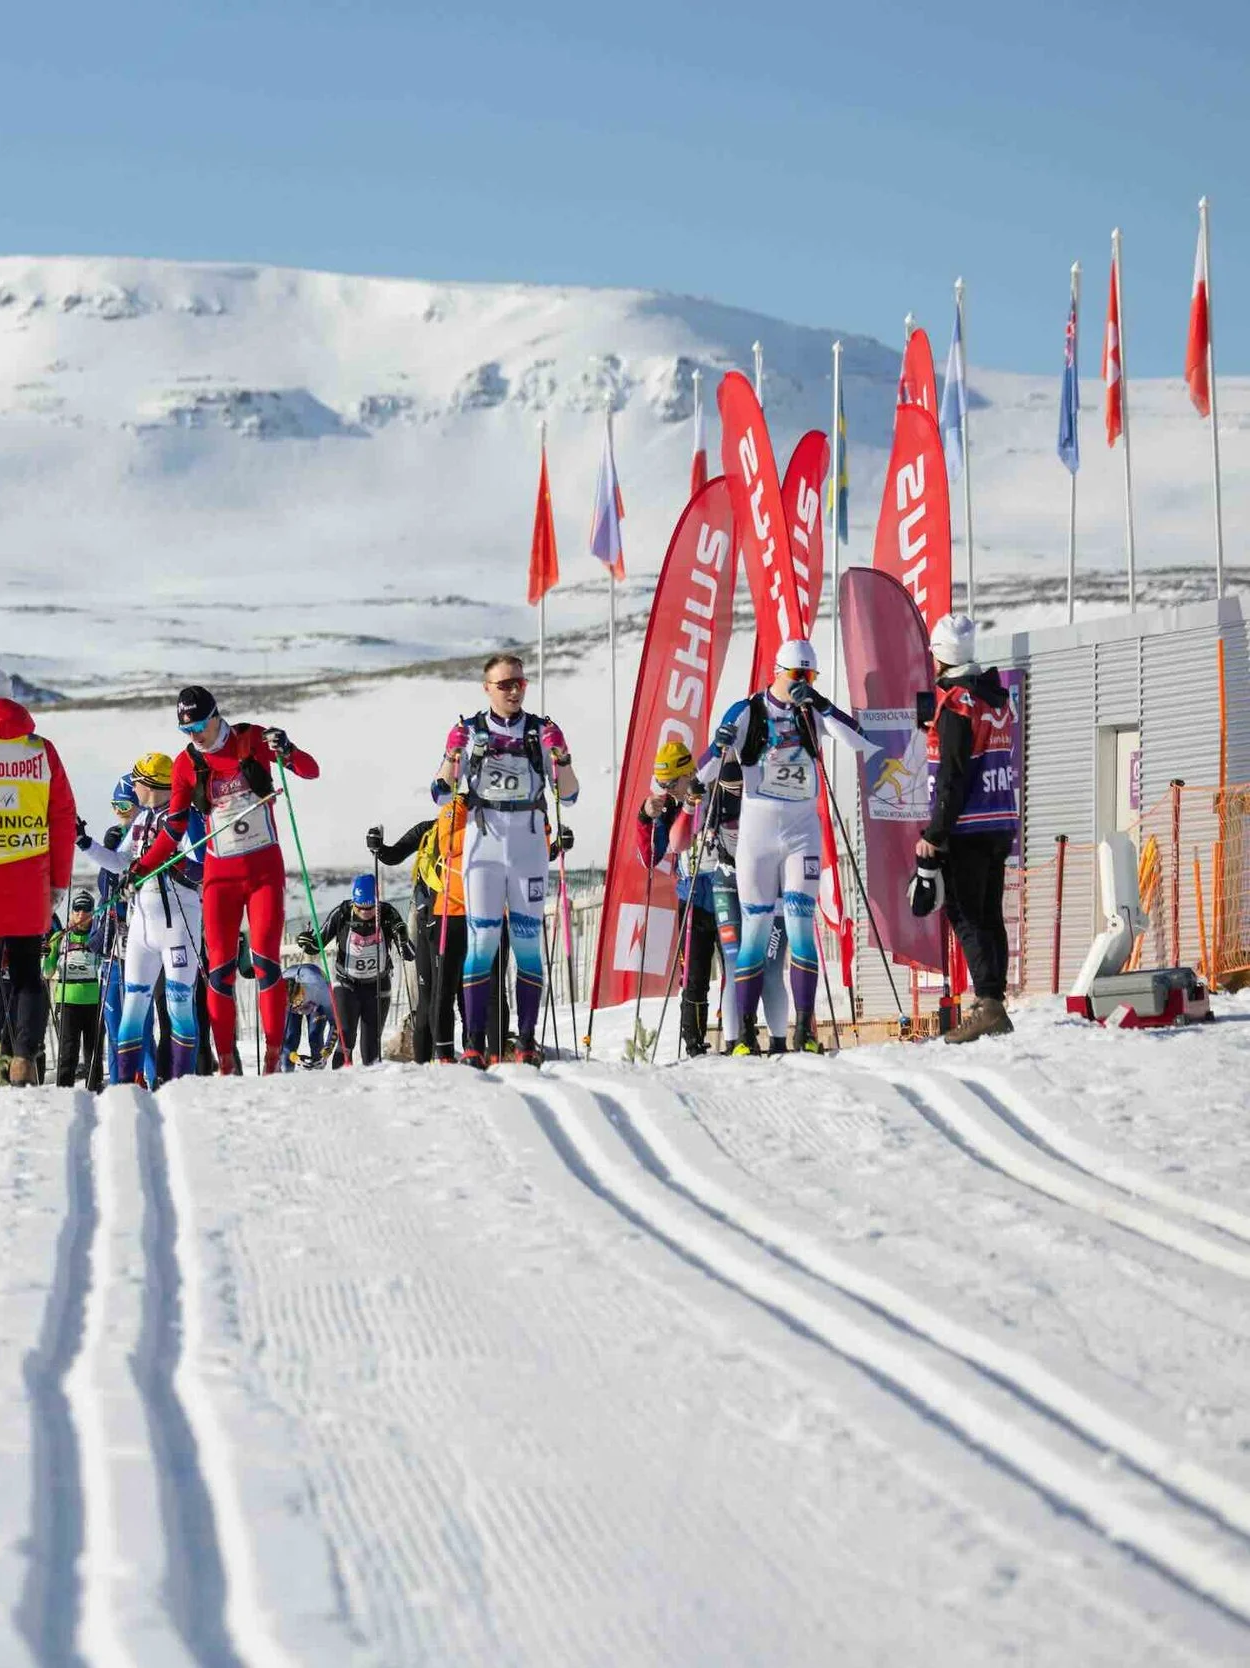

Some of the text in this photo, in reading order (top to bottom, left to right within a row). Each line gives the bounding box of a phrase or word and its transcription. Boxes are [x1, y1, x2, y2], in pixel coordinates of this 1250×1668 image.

[489, 770, 519, 790] 20
[776, 767, 806, 784] 34
[768, 926, 782, 959] SWIX
[355, 958, 377, 971] 82
